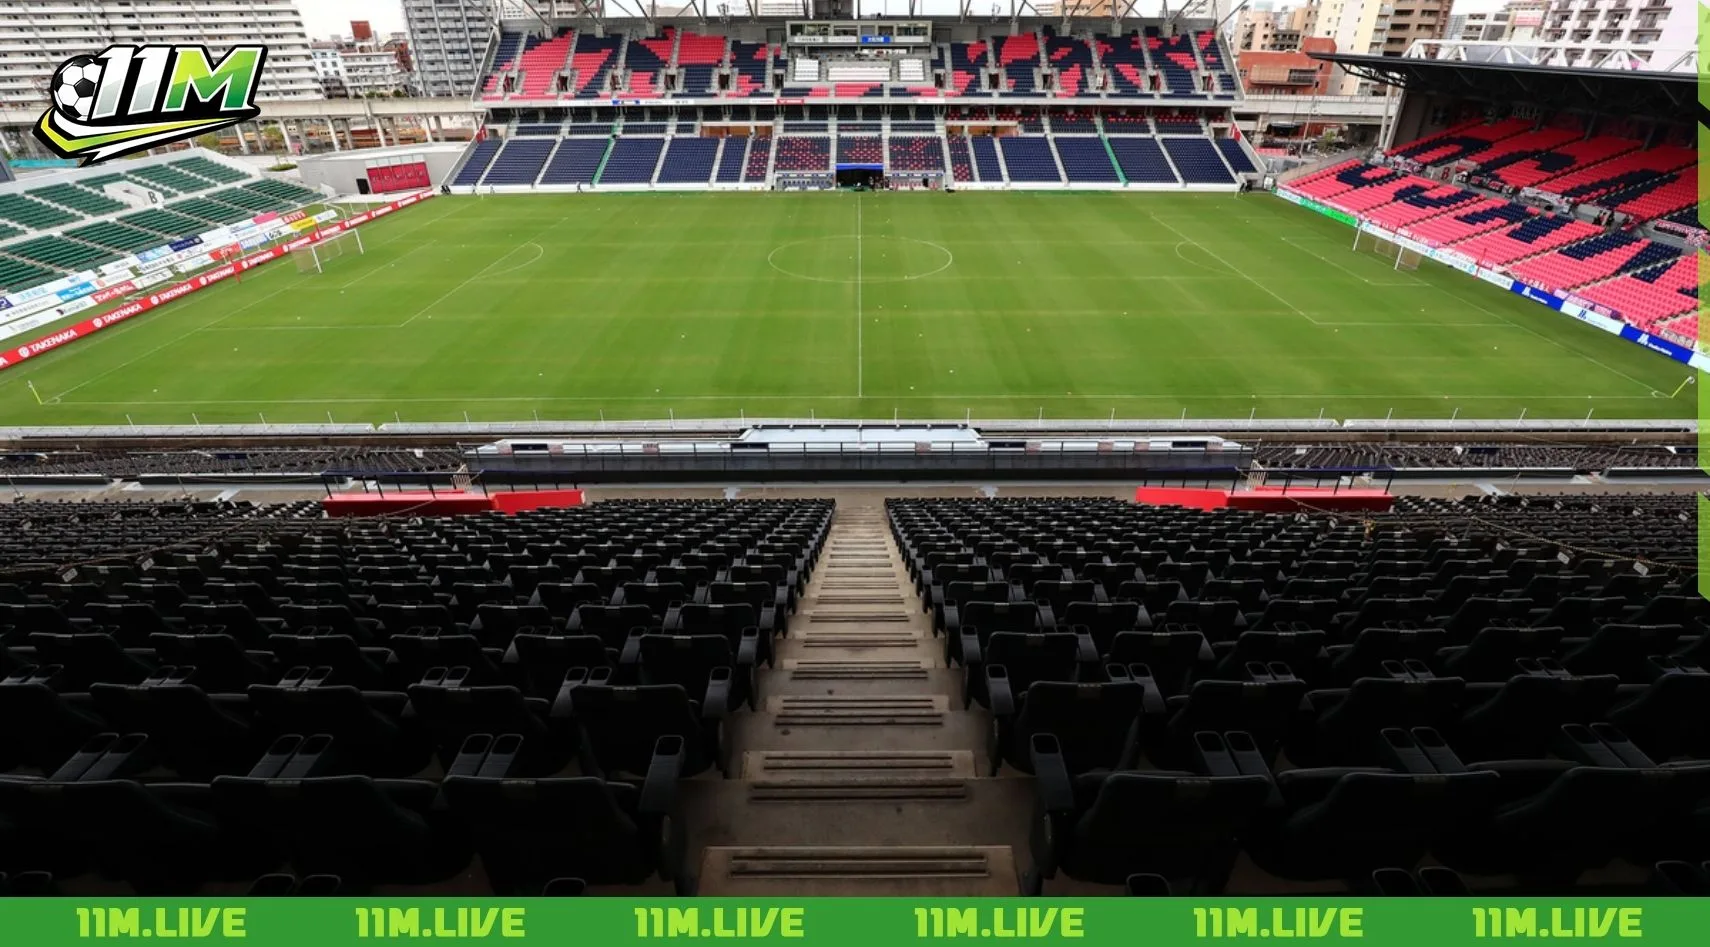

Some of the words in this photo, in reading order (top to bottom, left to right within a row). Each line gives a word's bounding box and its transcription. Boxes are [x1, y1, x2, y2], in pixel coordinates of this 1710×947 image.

[158, 283, 192, 301] TAKENAKA
[102, 303, 143, 324] TAKENAKA
[30, 329, 77, 352] TAKENAKA
